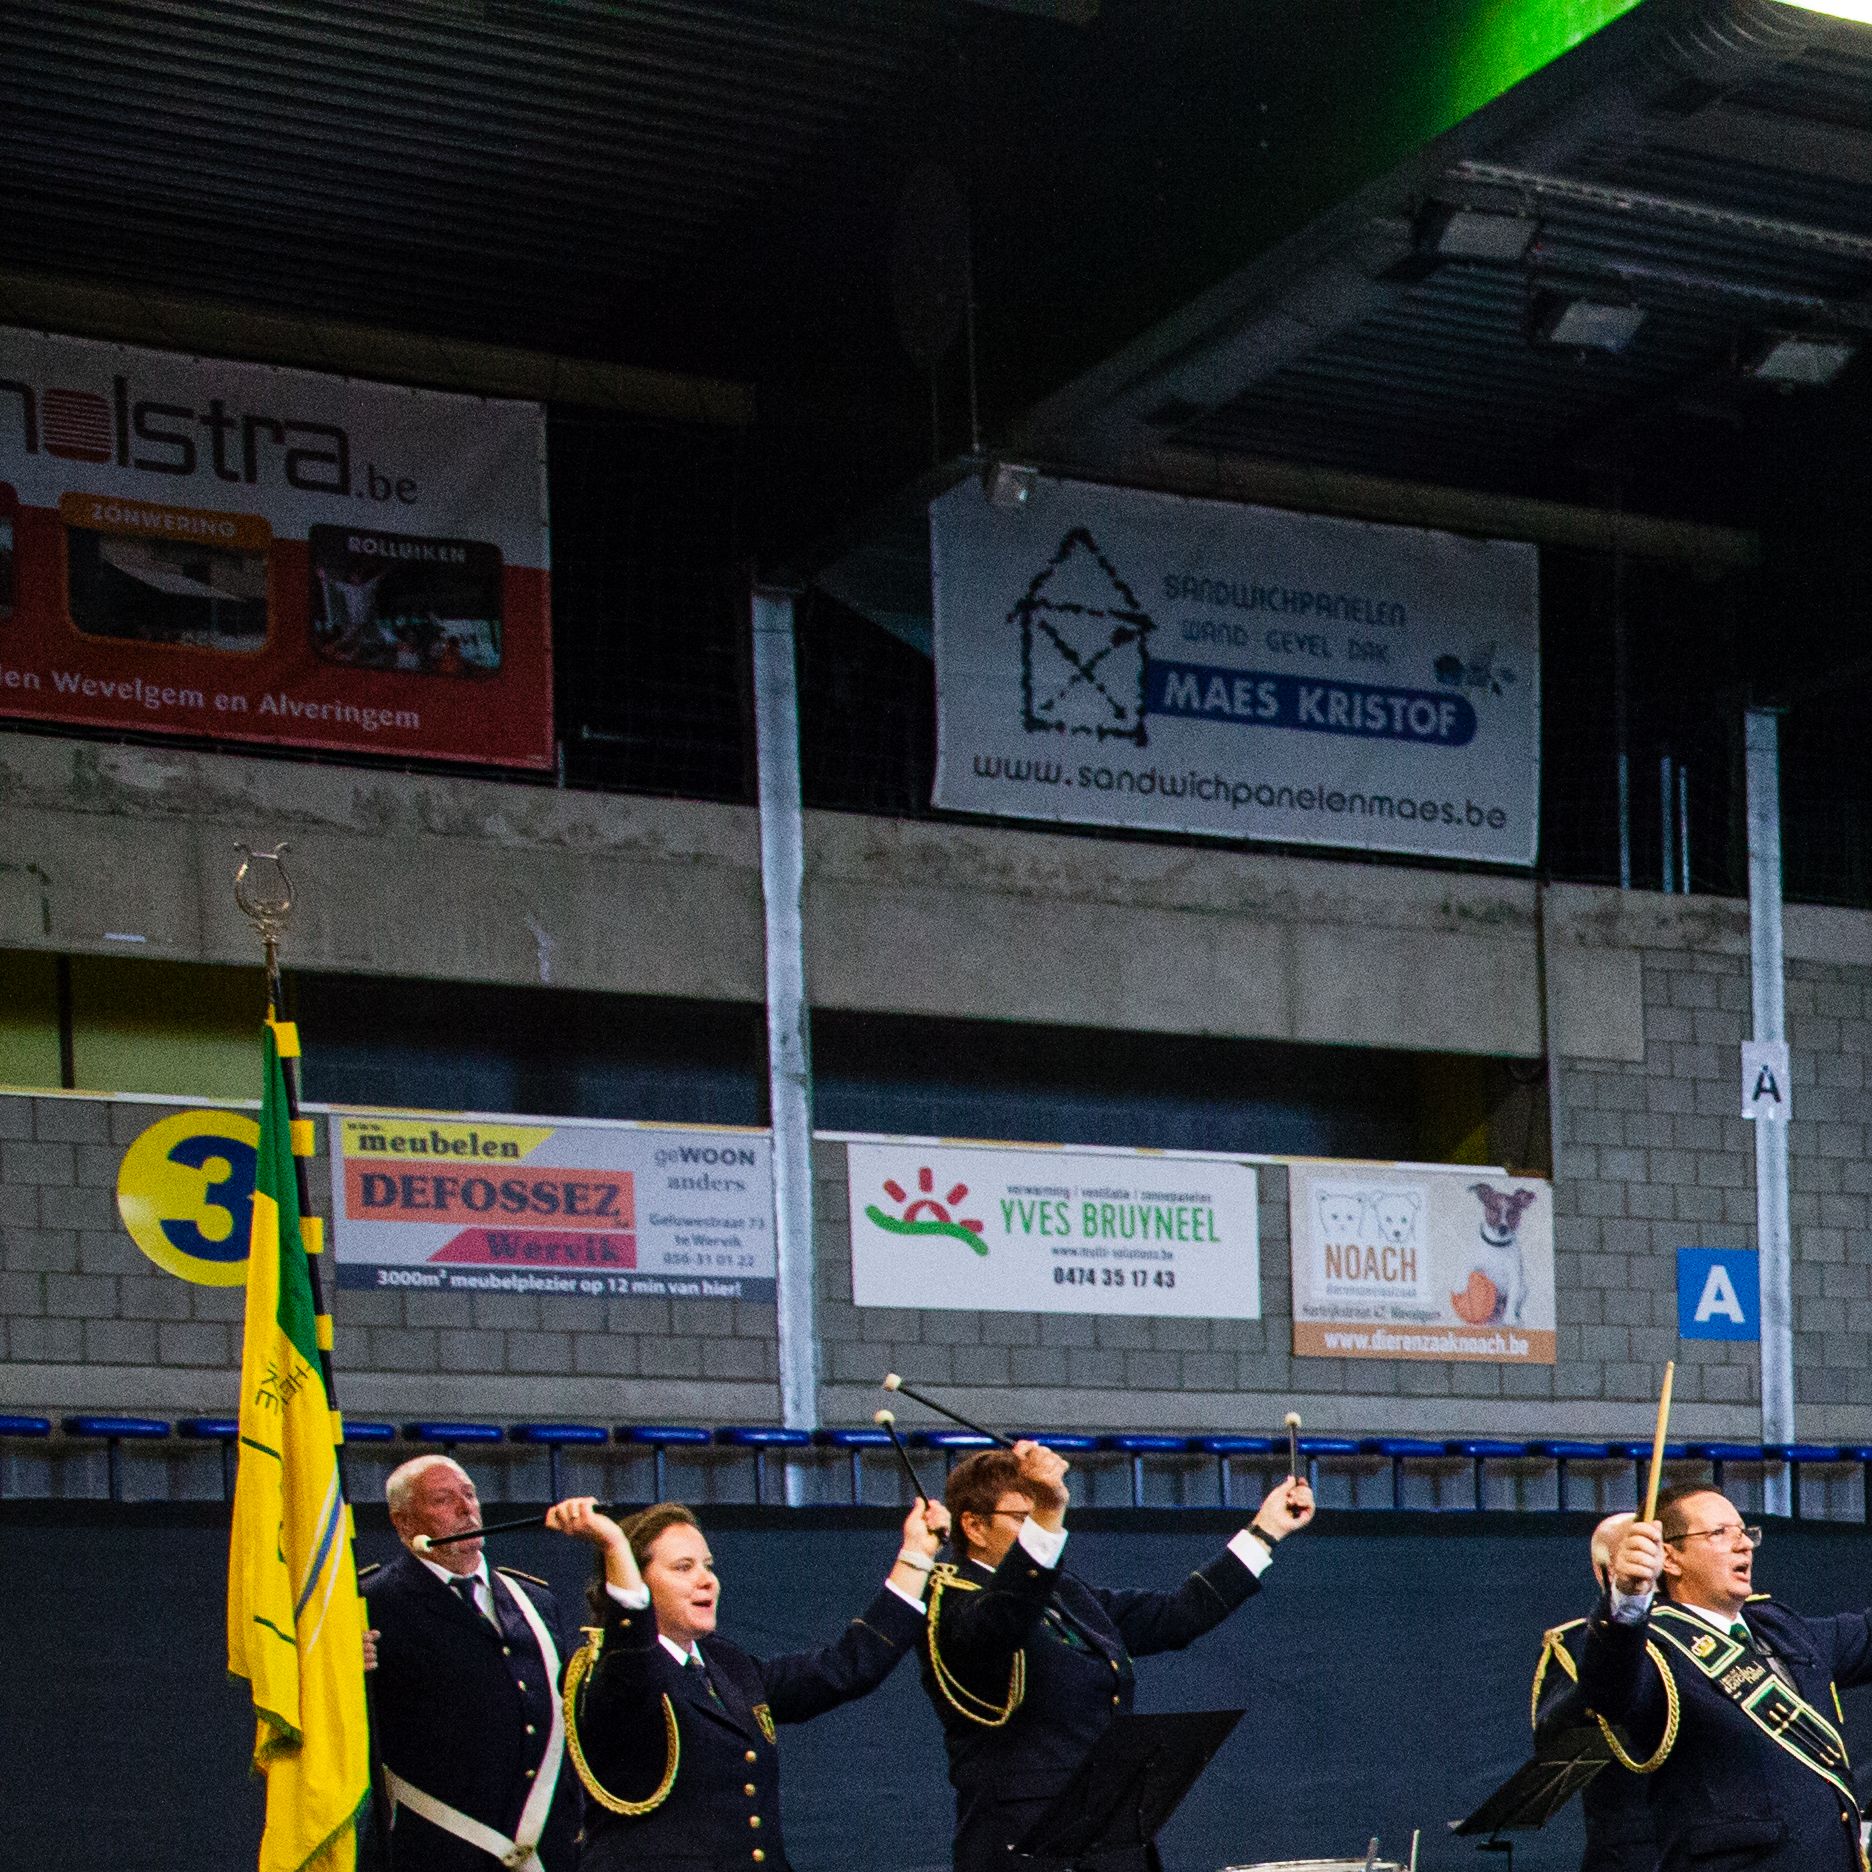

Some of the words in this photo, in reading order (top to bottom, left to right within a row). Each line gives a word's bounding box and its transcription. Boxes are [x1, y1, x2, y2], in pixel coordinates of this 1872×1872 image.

[91, 504, 237, 539] ZONWERING
[347, 535, 467, 565] ROLLUIKEN
[1266, 630, 1332, 659] GEVEL
[1347, 638, 1390, 664] DAK
[51, 669, 206, 709] Wevelgem
[213, 691, 249, 713] en
[258, 692, 421, 732] Alveringem
[1163, 670, 1280, 720] MAES
[1299, 686, 1457, 738] KRISTOF
[972, 752, 1508, 830] www.sandwichpanelenmaes.be
[1752, 1065, 1781, 1103] A
[358, 1130, 520, 1159] meubelen
[654, 1146, 756, 1169] geWOON
[160, 1135, 257, 1261] 3
[360, 1171, 622, 1219] DEFOSSEZ
[666, 1174, 747, 1193] anders
[1000, 1199, 1071, 1236] YVES
[1082, 1201, 1222, 1243] BRUYNEEL
[485, 1231, 623, 1263] Wervik
[1324, 1243, 1418, 1282] NOACH
[450, 1274, 576, 1295] meubelplezier
[580, 1280, 603, 1296] op
[608, 1278, 628, 1293] 12
[632, 1278, 666, 1294] min
[669, 1282, 700, 1295] van
[703, 1279, 742, 1297] hier!
[1053, 1266, 1096, 1286] 0474
[1102, 1268, 1125, 1287] 35
[1132, 1269, 1148, 1288] 17
[1153, 1270, 1176, 1289] 43
[1694, 1264, 1746, 1324] A
